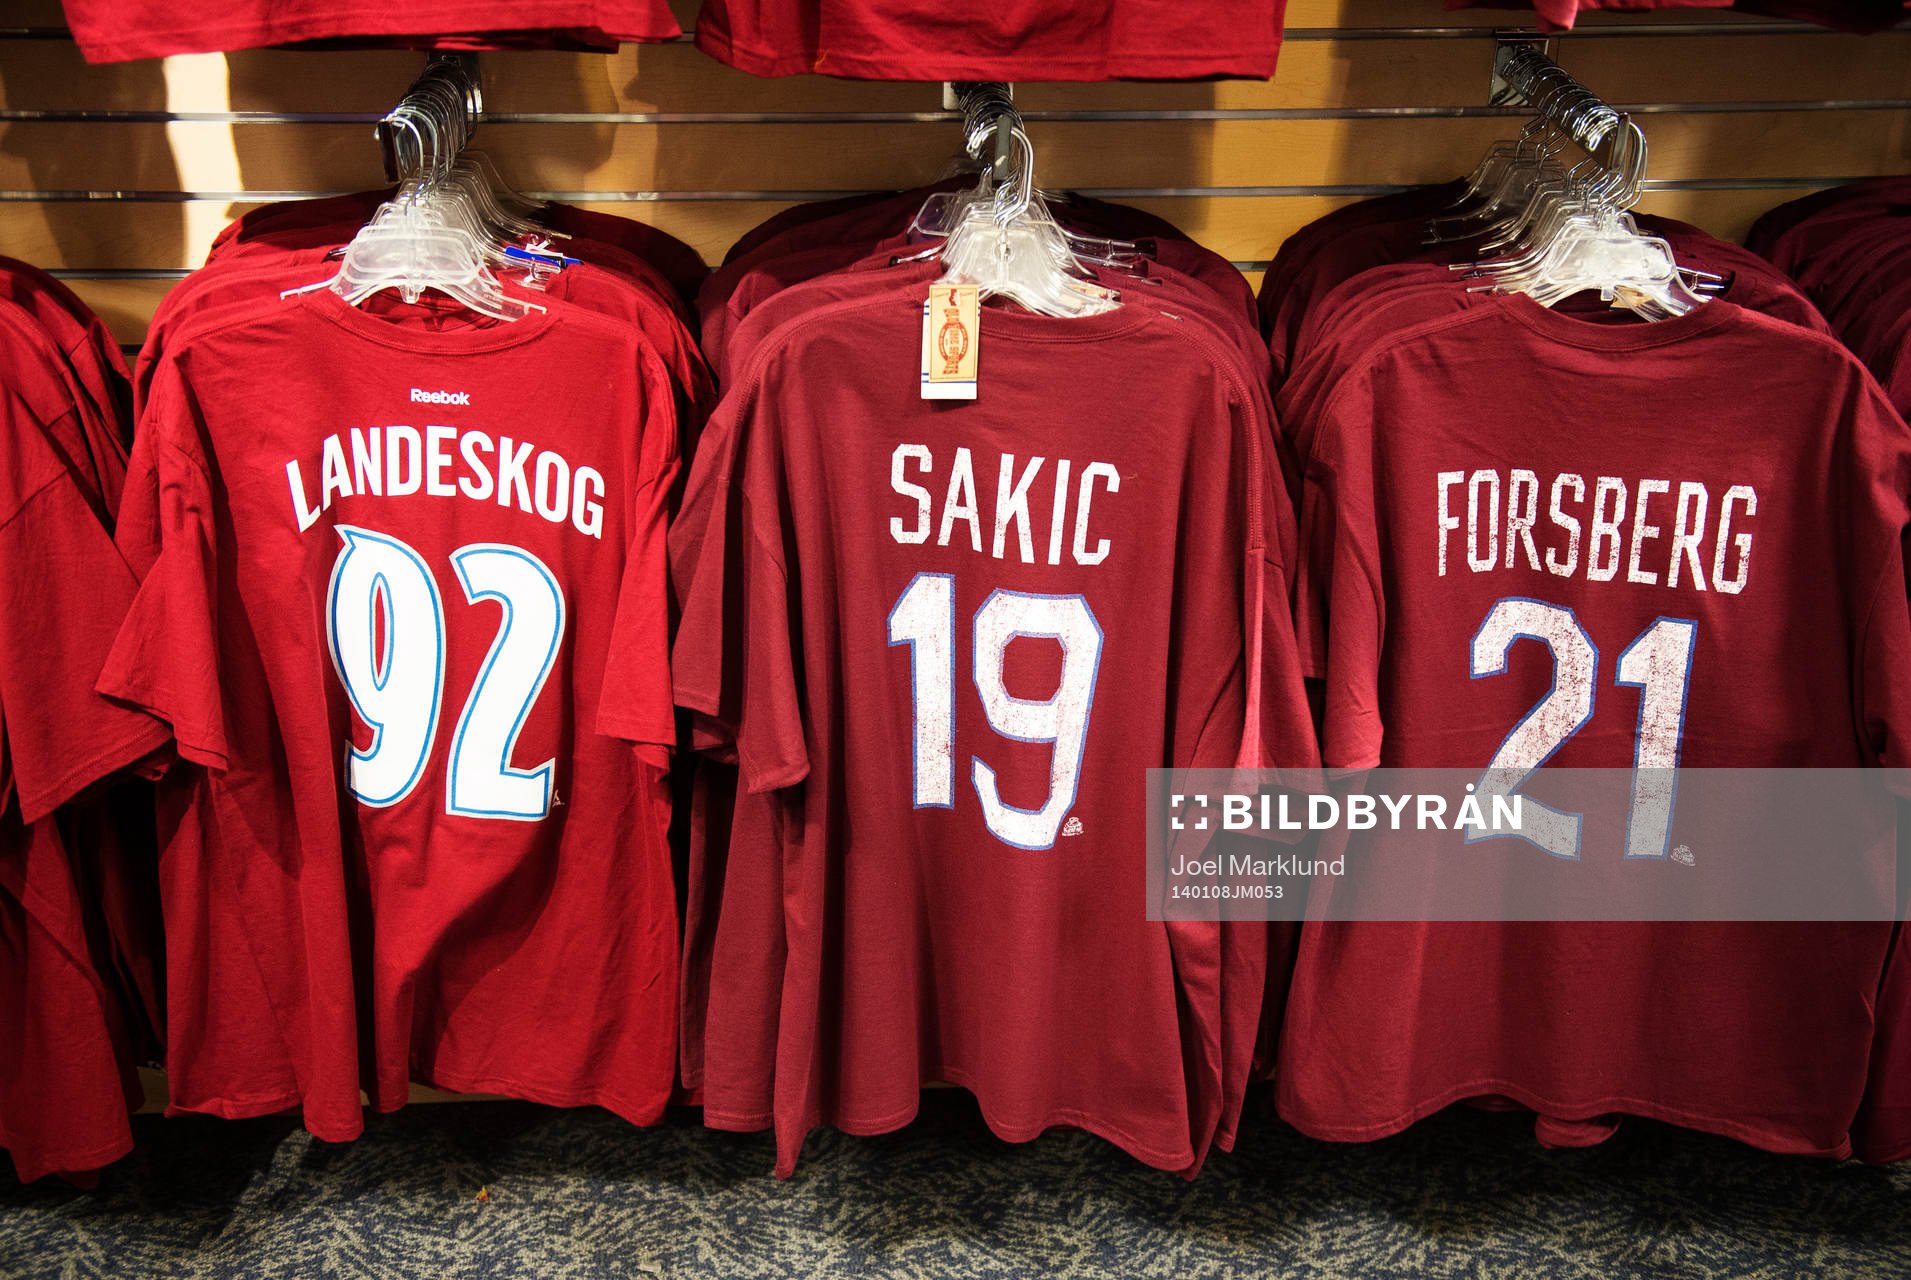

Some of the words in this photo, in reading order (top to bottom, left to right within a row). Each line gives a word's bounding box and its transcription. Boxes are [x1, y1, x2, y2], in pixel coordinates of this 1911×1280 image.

[410, 388, 471, 406] Reebok
[286, 425, 604, 540] LANDESKOG
[889, 443, 1120, 566] SAKIC
[1437, 468, 1758, 595] FORSBERG
[325, 524, 567, 822] 92
[887, 571, 1105, 851] 19
[1464, 597, 1697, 863] 21
